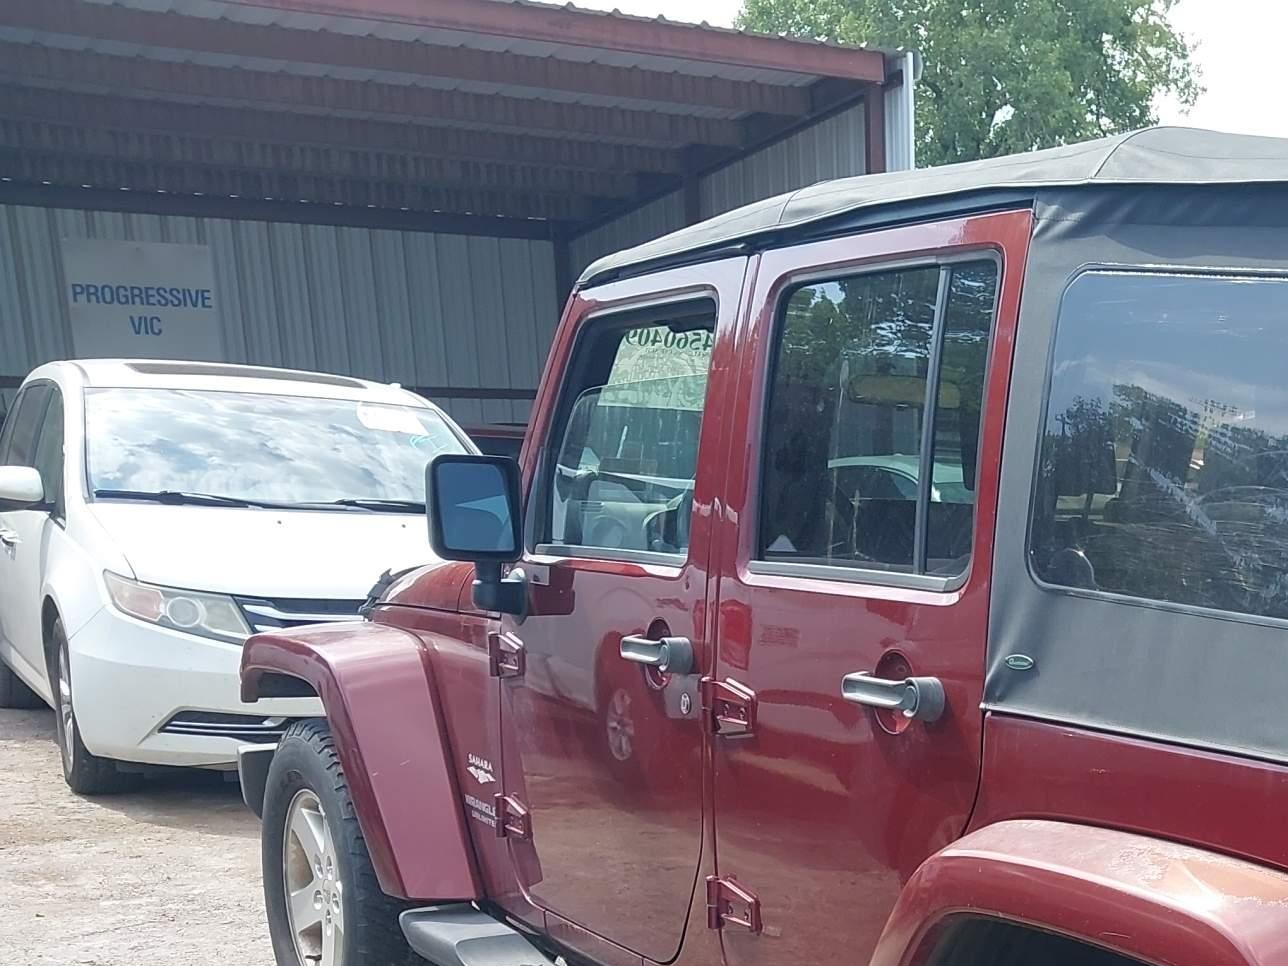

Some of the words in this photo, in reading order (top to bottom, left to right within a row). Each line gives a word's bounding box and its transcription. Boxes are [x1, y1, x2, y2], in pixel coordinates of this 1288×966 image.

[71, 283, 213, 309] PROGRESSIVE
[129, 315, 163, 336] VIC
[468, 753, 493, 772] SAHARA
